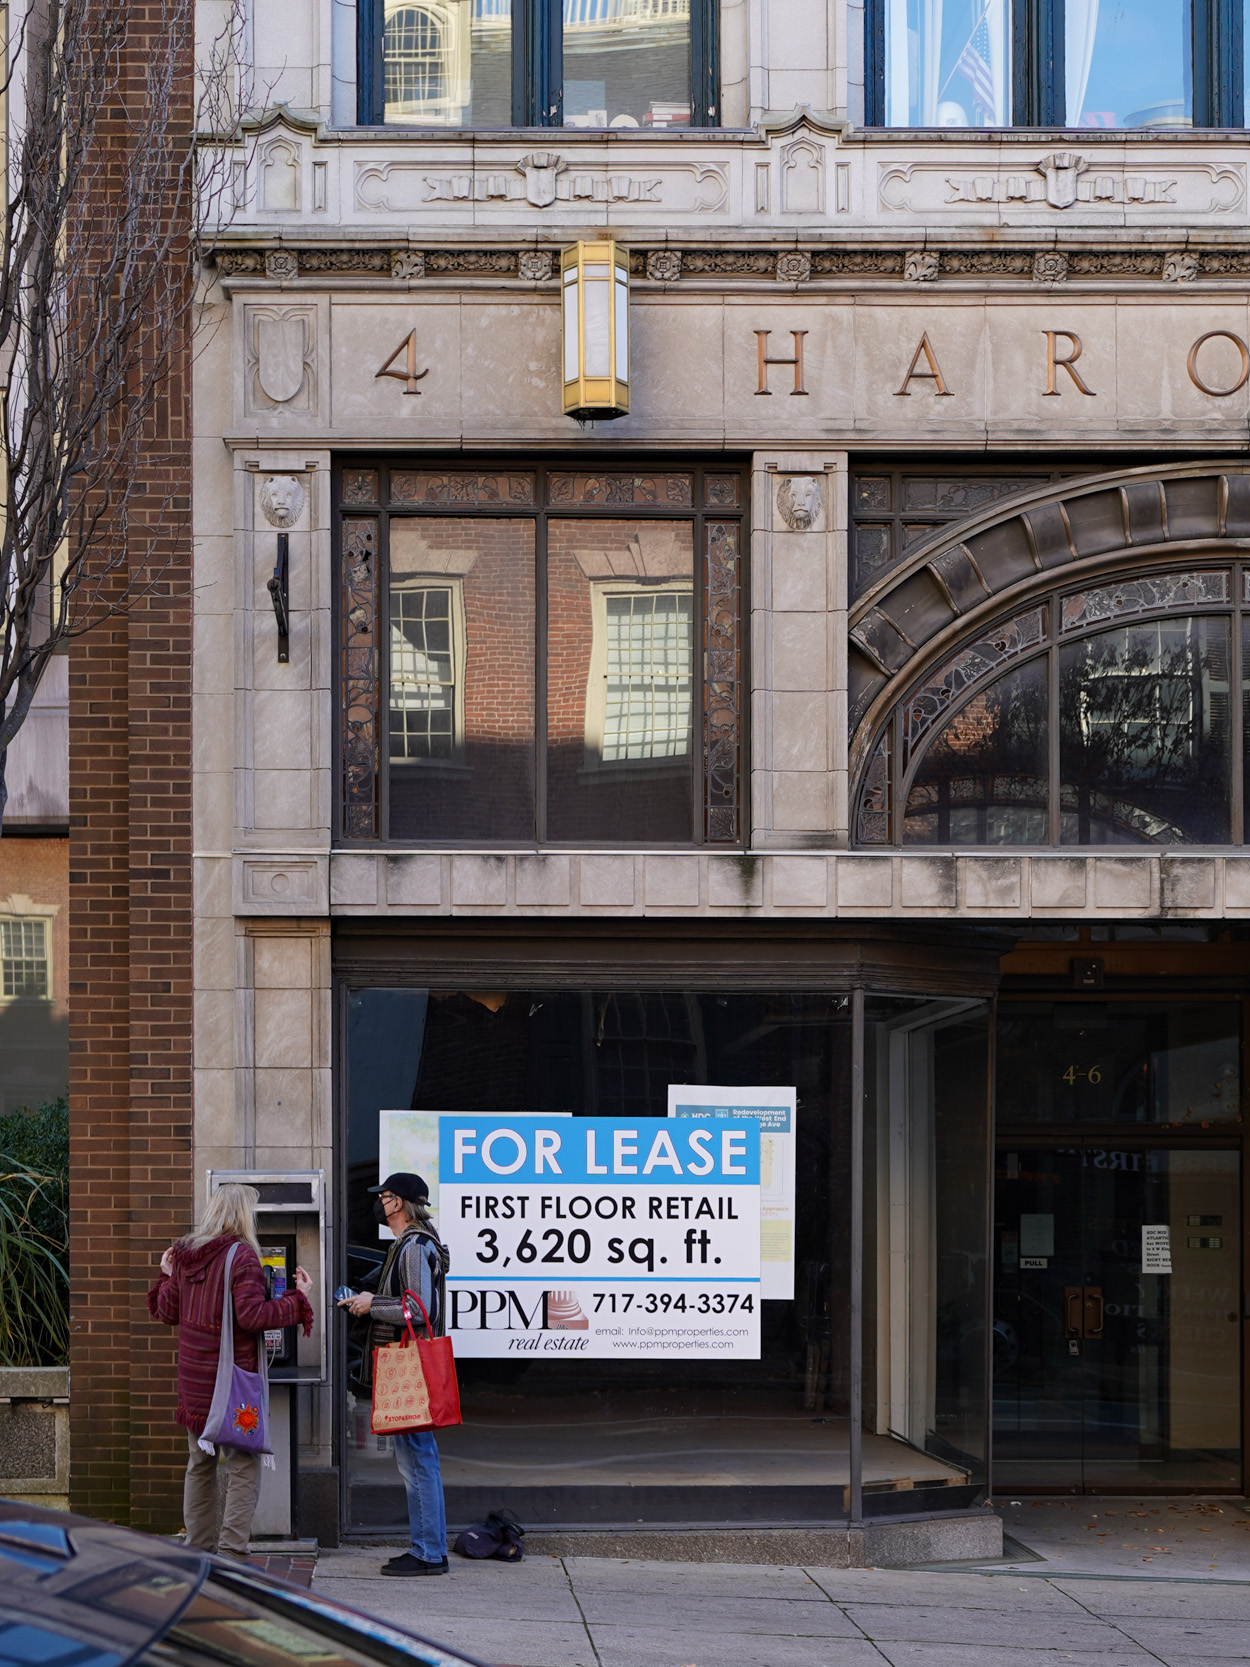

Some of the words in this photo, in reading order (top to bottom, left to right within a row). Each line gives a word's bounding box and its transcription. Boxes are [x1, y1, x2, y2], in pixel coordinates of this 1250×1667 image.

[375, 328, 429, 396] 4
[1062, 1064, 1102, 1086] 4-6
[733, 1109, 786, 1117] Redevelopment
[453, 1128, 563, 1176] FOR
[586, 1128, 747, 1176] LEASE
[461, 1195, 530, 1220] FIRST
[540, 1195, 636, 1220] FLOOR
[648, 1196, 739, 1220] RETAIL
[475, 1228, 592, 1268] 3,620
[606, 1236, 668, 1273] sq.
[683, 1228, 723, 1265] ft.
[448, 1290, 552, 1330] PPM
[592, 1293, 755, 1314] 717-394-3374
[508, 1333, 542, 1351] real
[543, 1337, 590, 1351] estate
[595, 1327, 624, 1336] email:
[628, 1327, 749, 1339] Info@ppmproperties.com
[612, 1340, 735, 1350] www.ppmproperties.com
